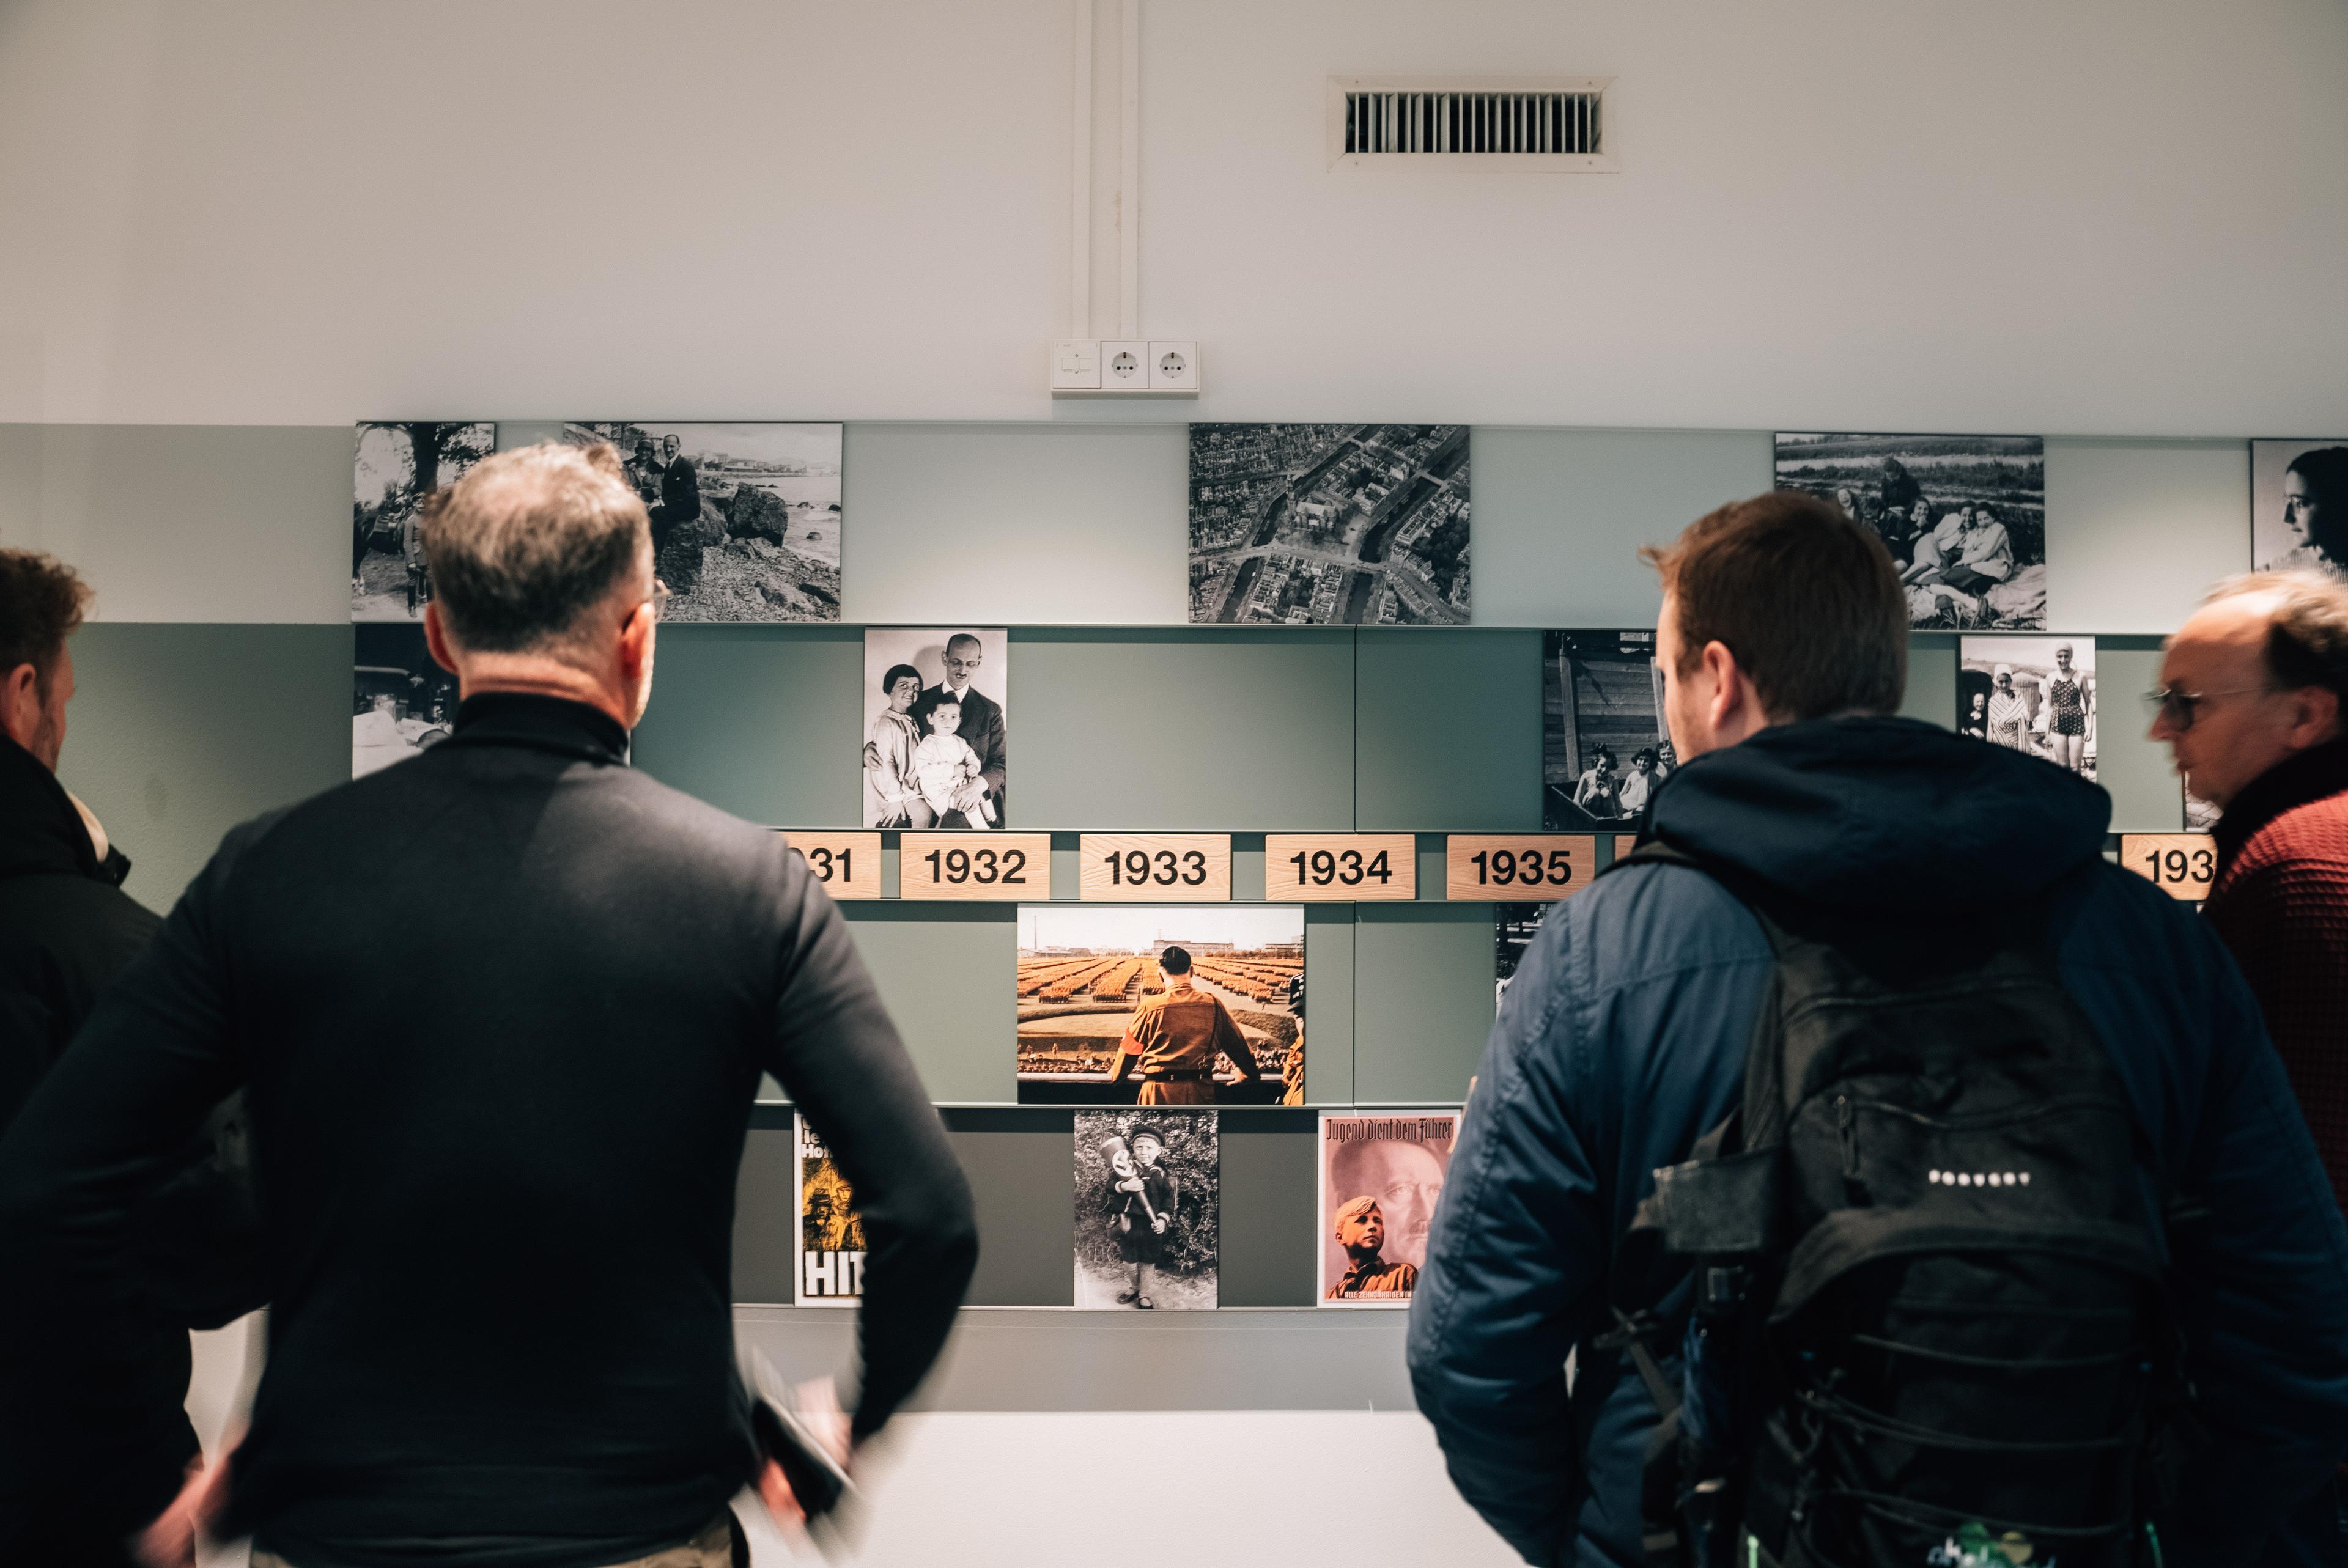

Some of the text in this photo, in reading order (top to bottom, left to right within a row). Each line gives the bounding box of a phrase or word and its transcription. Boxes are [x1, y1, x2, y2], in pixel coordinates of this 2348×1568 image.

[788, 847, 851, 882] 31
[924, 848, 1027, 884] 1932
[1104, 850, 1207, 885] 1933
[1290, 850, 1393, 885] 1934
[1471, 850, 1572, 885] 1935
[2146, 850, 2214, 883] 193
[1326, 1117, 1453, 1143] Jugend dient dem Führer
[805, 1251, 868, 1295] HIT
